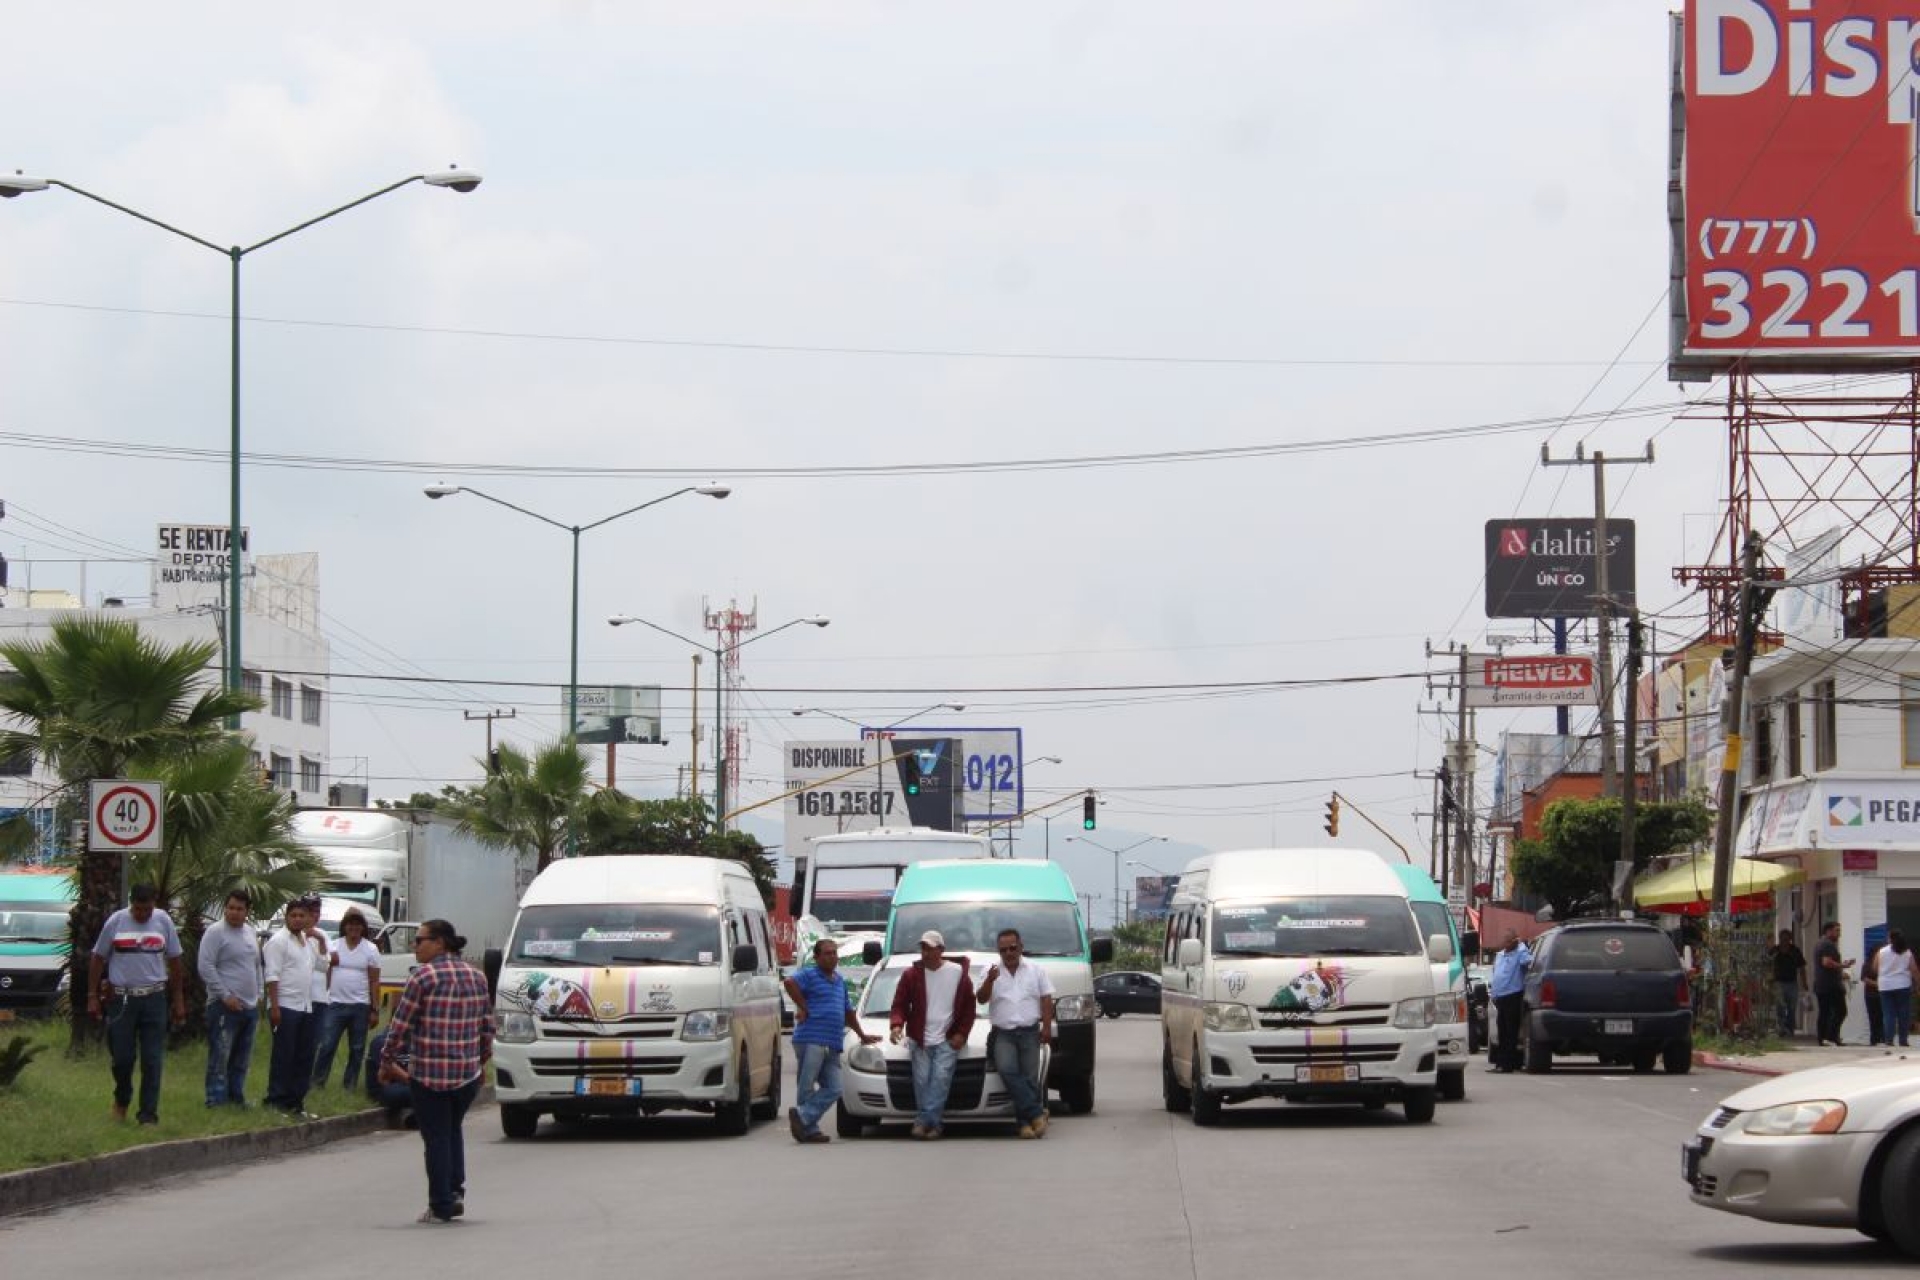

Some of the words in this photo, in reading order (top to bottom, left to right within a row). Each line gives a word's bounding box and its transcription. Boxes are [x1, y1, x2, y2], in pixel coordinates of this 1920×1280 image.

[1700, 217, 1817, 260] (777)
[1700, 268, 1920, 339] 3221
[160, 527, 181, 549] SE
[1491, 663, 1585, 682] HELVEX
[792, 748, 865, 769] DISPONIBLE
[962, 754, 1014, 791] 012
[114, 799, 140, 823] 40
